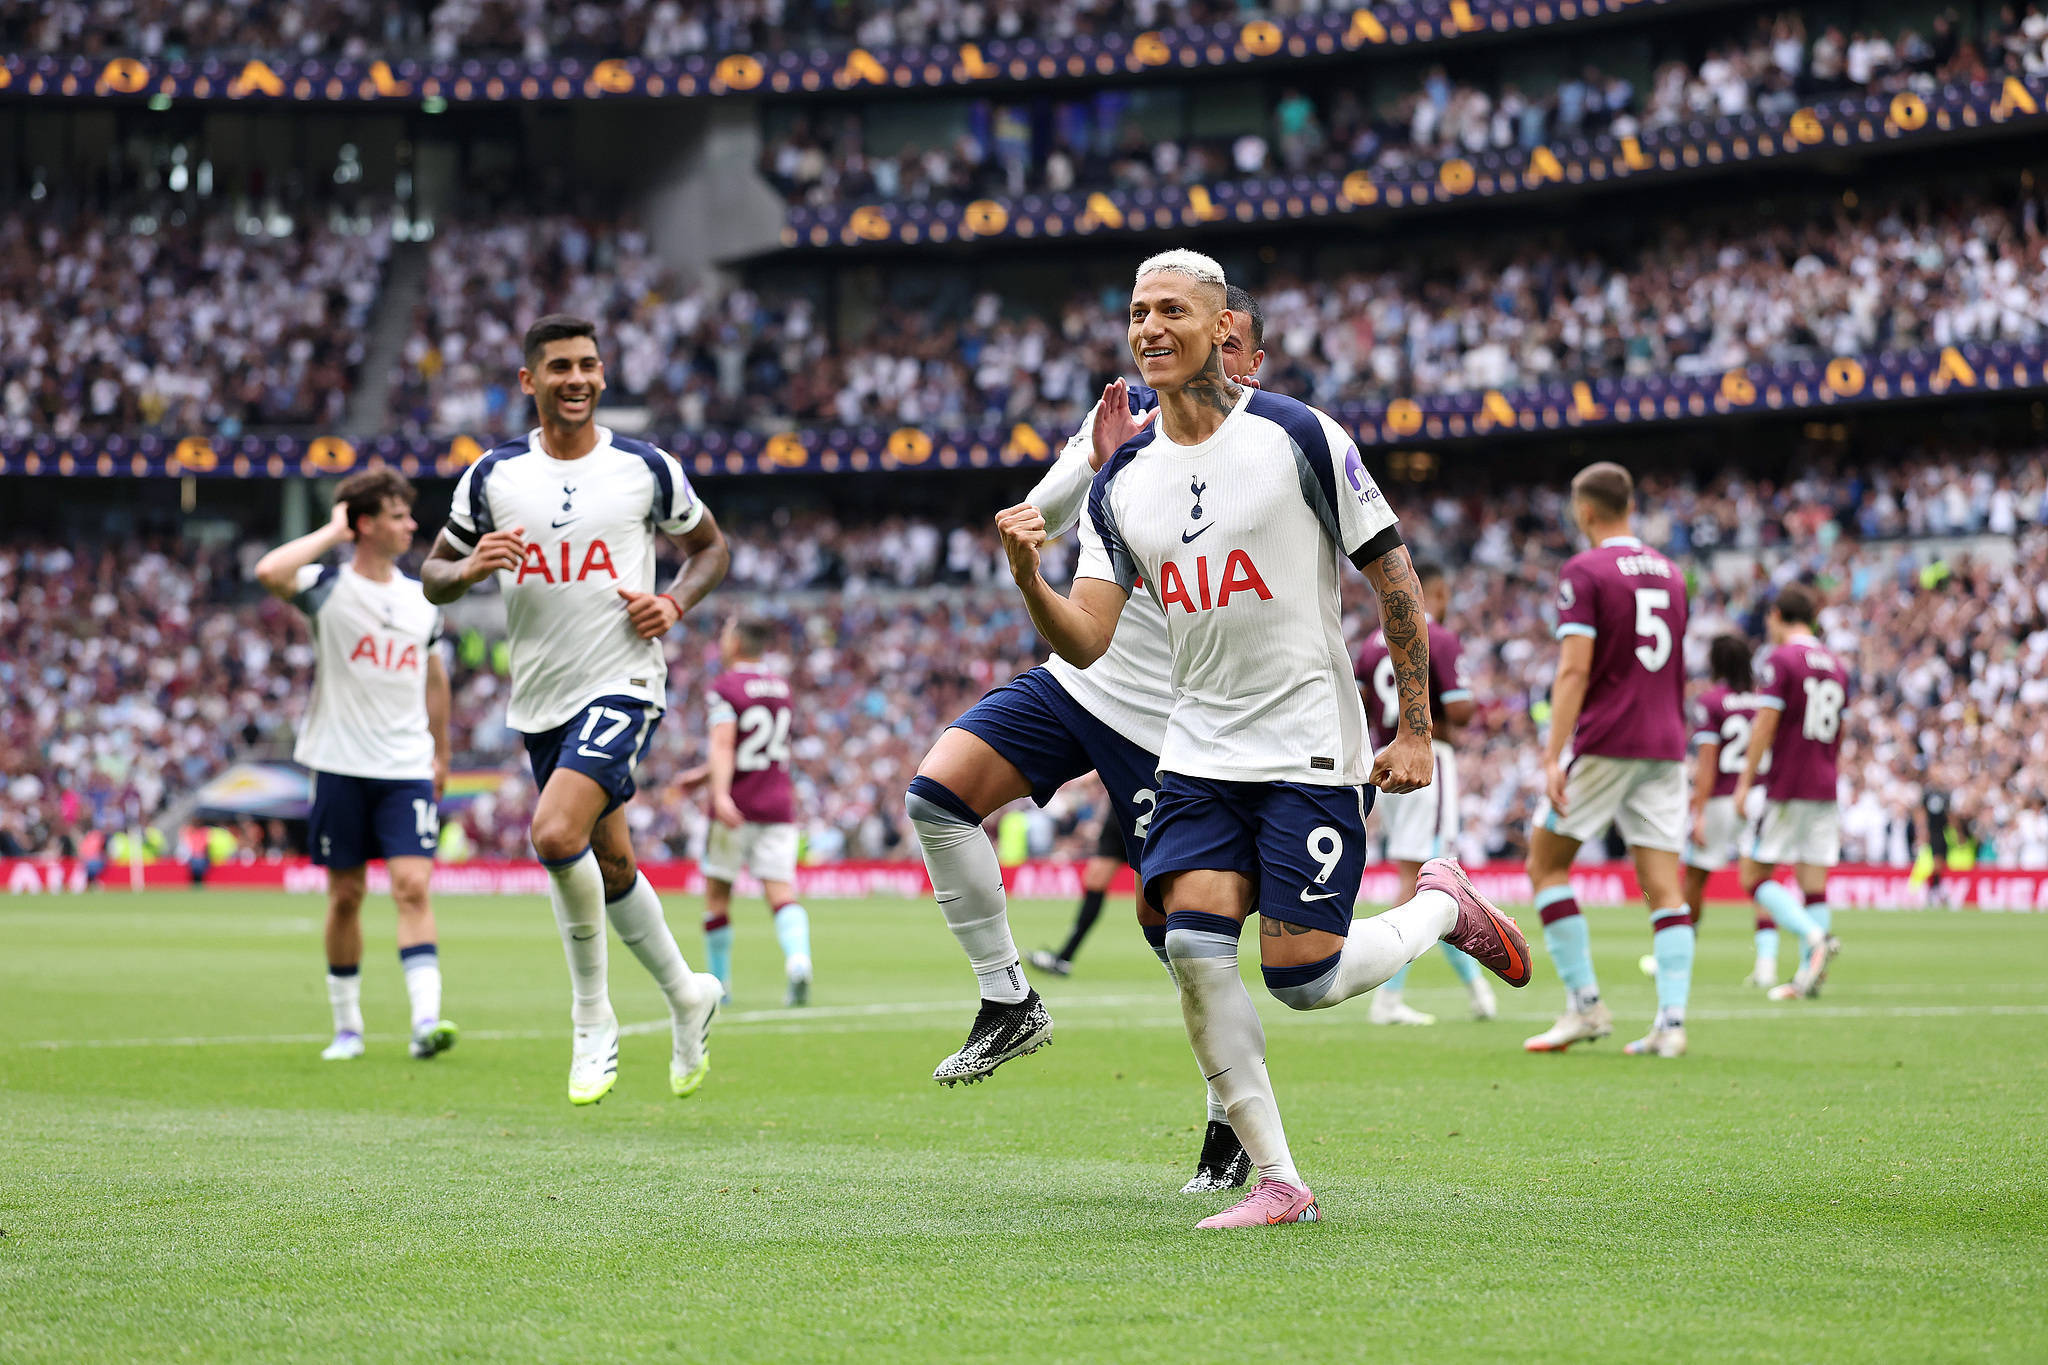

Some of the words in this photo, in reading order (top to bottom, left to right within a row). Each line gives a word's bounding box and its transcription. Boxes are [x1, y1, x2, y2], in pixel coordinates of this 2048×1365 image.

[516, 539, 618, 585] AIA
[1161, 549, 1274, 614] AIA
[350, 634, 420, 672] AIA
[1635, 587, 1673, 673] 5
[578, 705, 632, 748] 17
[1803, 676, 1845, 744] 18
[1719, 713, 1774, 776] 2
[1306, 826, 1344, 884] 9
